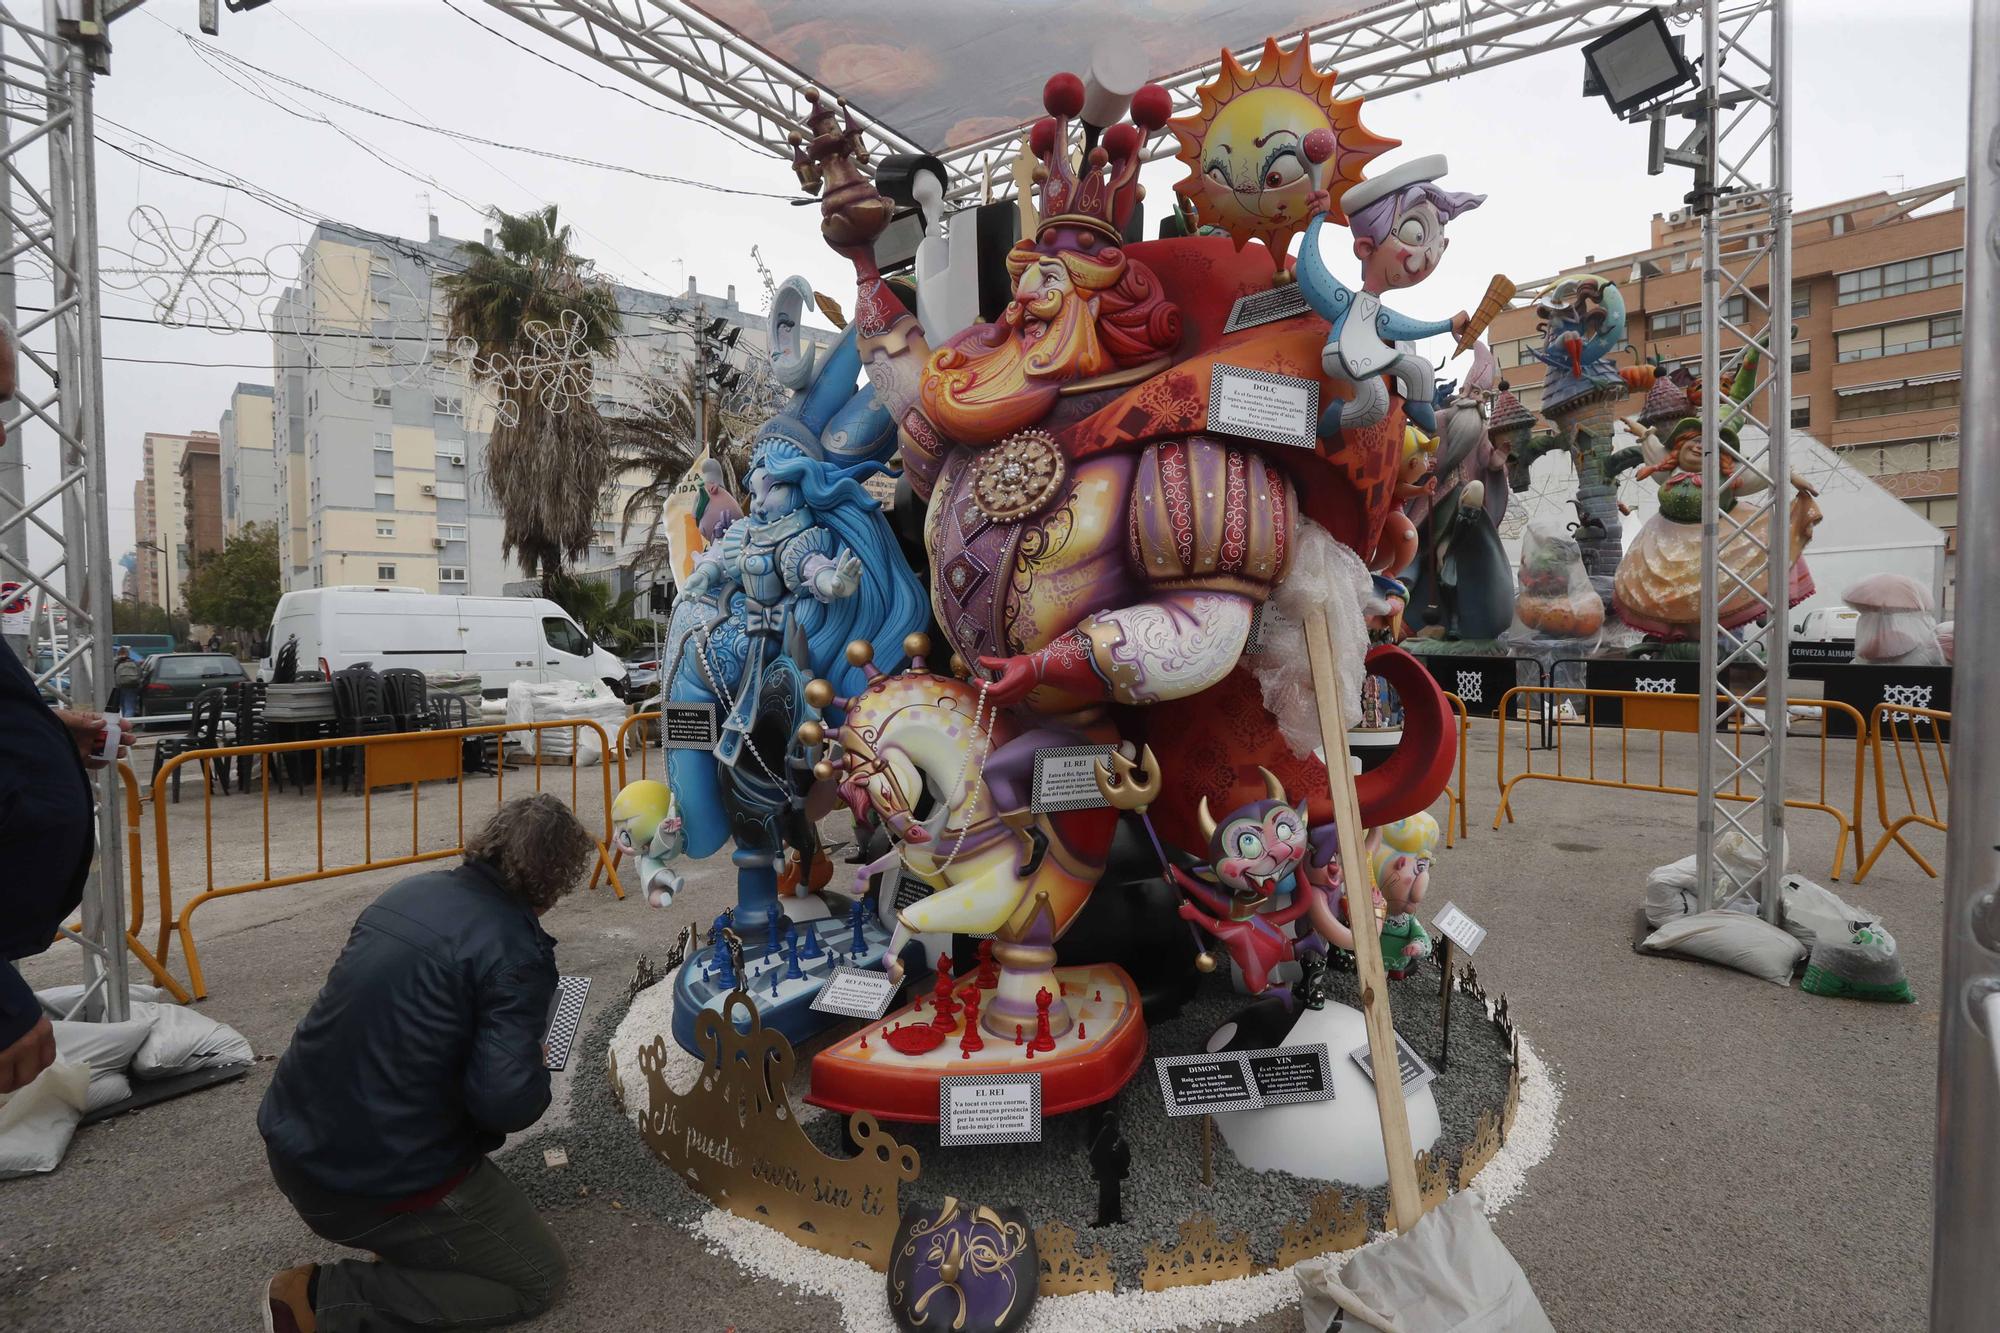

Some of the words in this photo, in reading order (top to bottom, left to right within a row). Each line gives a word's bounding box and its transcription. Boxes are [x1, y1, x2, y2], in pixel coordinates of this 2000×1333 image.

[1253, 383, 1278, 395] DOLÇ
[687, 472, 702, 481] LA
[1792, 648, 1826, 656] CERVEZAS
[1189, 1064, 1220, 1073] DIMONI
[812, 1176, 853, 1208] sin
[861, 1183, 885, 1216] ti
